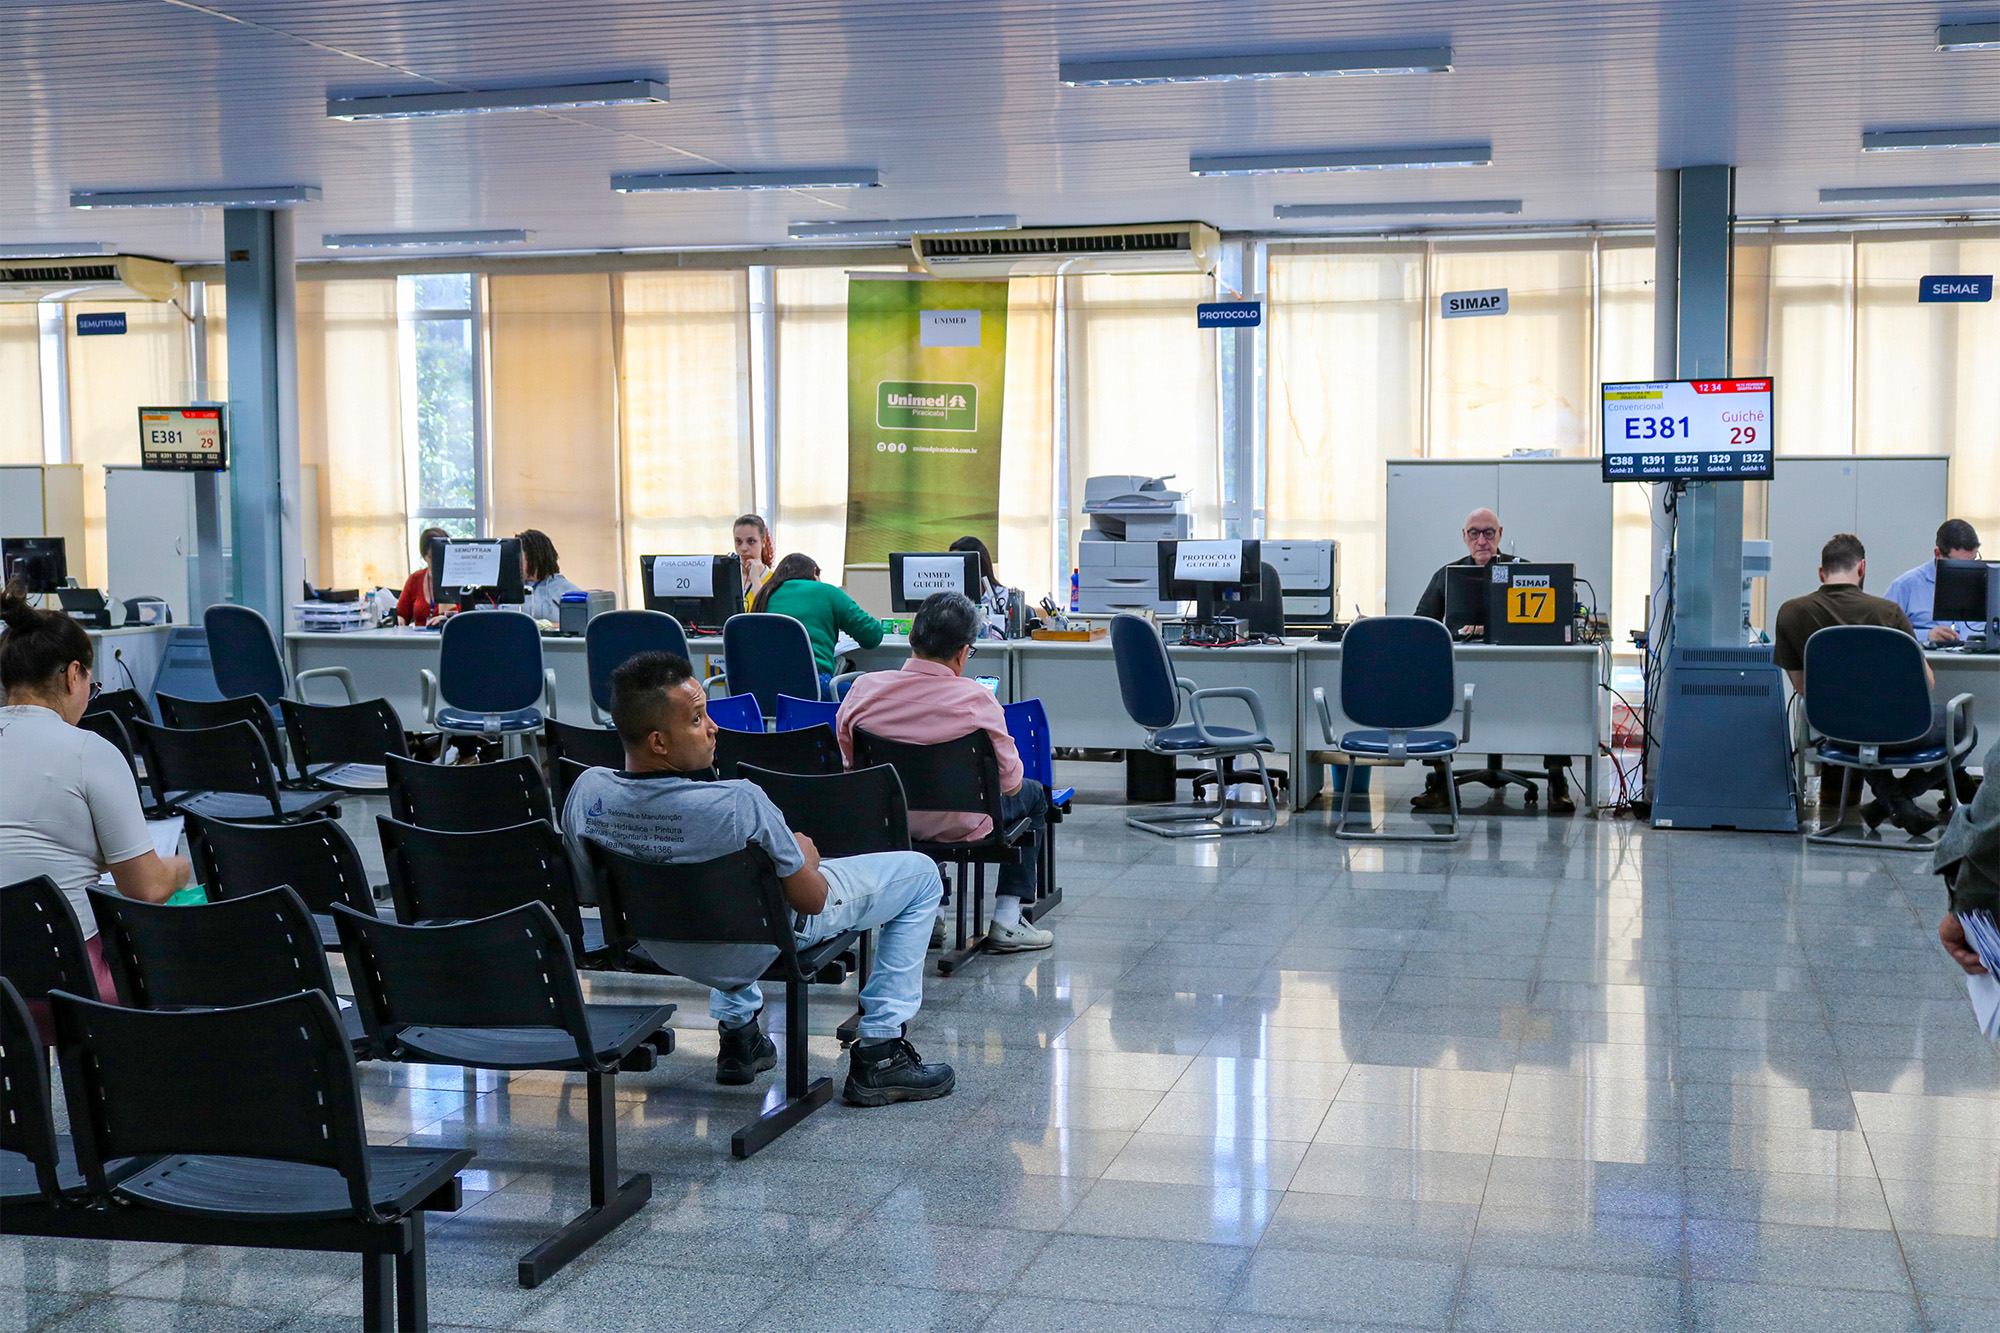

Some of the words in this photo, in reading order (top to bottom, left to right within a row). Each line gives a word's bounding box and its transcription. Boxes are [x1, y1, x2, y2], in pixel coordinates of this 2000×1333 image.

[1932, 283, 1979, 294] SEMAE
[1449, 296, 1501, 311] SIMAP
[1199, 310, 1258, 320] PROTOCOLO
[79, 319, 125, 329] SEMUTTRAN
[1699, 383, 1709, 392] 12
[1711, 383, 1722, 391] 34
[887, 393, 945, 407] Unimed
[1608, 401, 1664, 412] Convencional
[912, 408, 945, 417] Piracicaba
[1721, 410, 1765, 423] Guichê
[1626, 416, 1689, 439] E381
[152, 430, 182, 443] E381
[1730, 426, 1756, 445] 29
[201, 438, 214, 448] 29
[912, 446, 978, 454] unimedpiracicaba.com.br
[1609, 456, 1634, 466] C388
[1641, 455, 1665, 465] R391
[1674, 455, 1699, 465] E375
[1182, 553, 1236, 561] PROTOCOLO
[1186, 560, 1220, 568] GUICHÊ
[676, 577, 691, 589] 20
[913, 579, 945, 588] GUICHÊ
[1515, 591, 1548, 619] 17
[607, 808, 635, 819] Reformas
[641, 813, 683, 822] Manutenção
[614, 822, 649, 833] Hidráulica
[655, 825, 682, 834] Pintura
[612, 830, 648, 841] Carpintaria
[654, 834, 685, 843] Pedreiro
